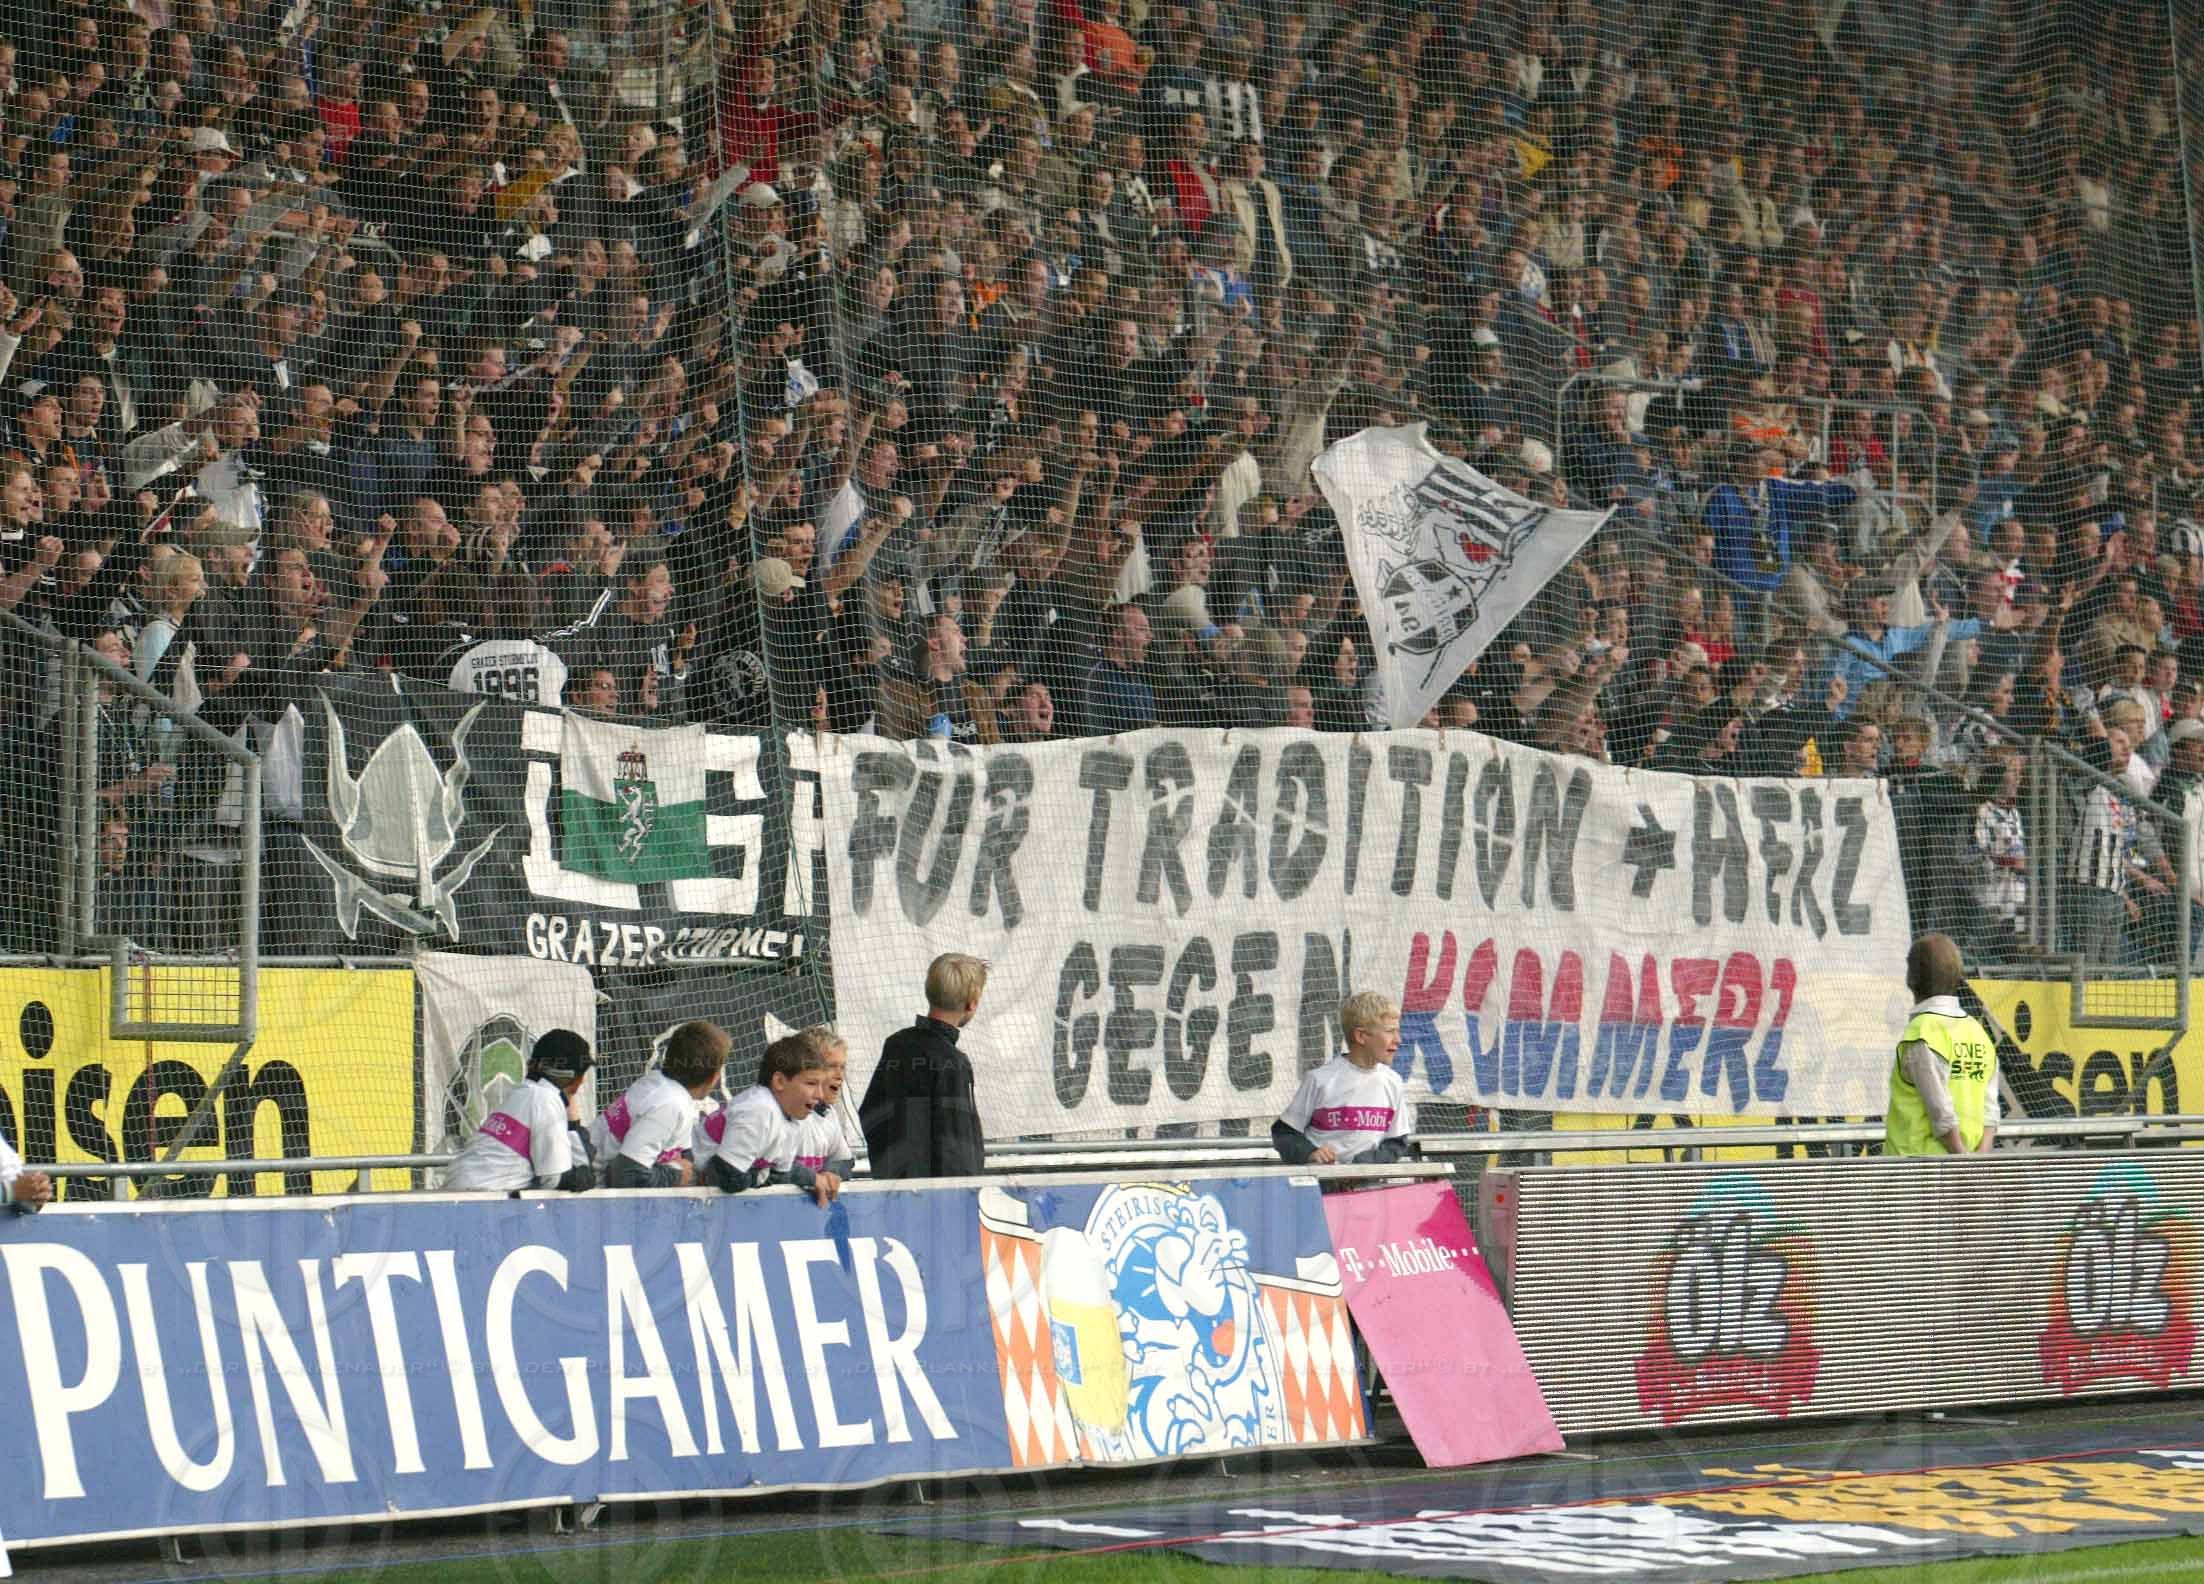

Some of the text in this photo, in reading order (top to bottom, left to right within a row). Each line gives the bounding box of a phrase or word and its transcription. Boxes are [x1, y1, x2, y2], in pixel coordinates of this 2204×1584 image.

[1079, 741, 1592, 918] TRADITION
[1692, 781, 1872, 941] HERZ
[526, 912, 666, 969] GRAZER
[1053, 928, 1797, 1112] GEGEN KOMMERZ
[0, 1237, 959, 1499] PUNTIGAMER
